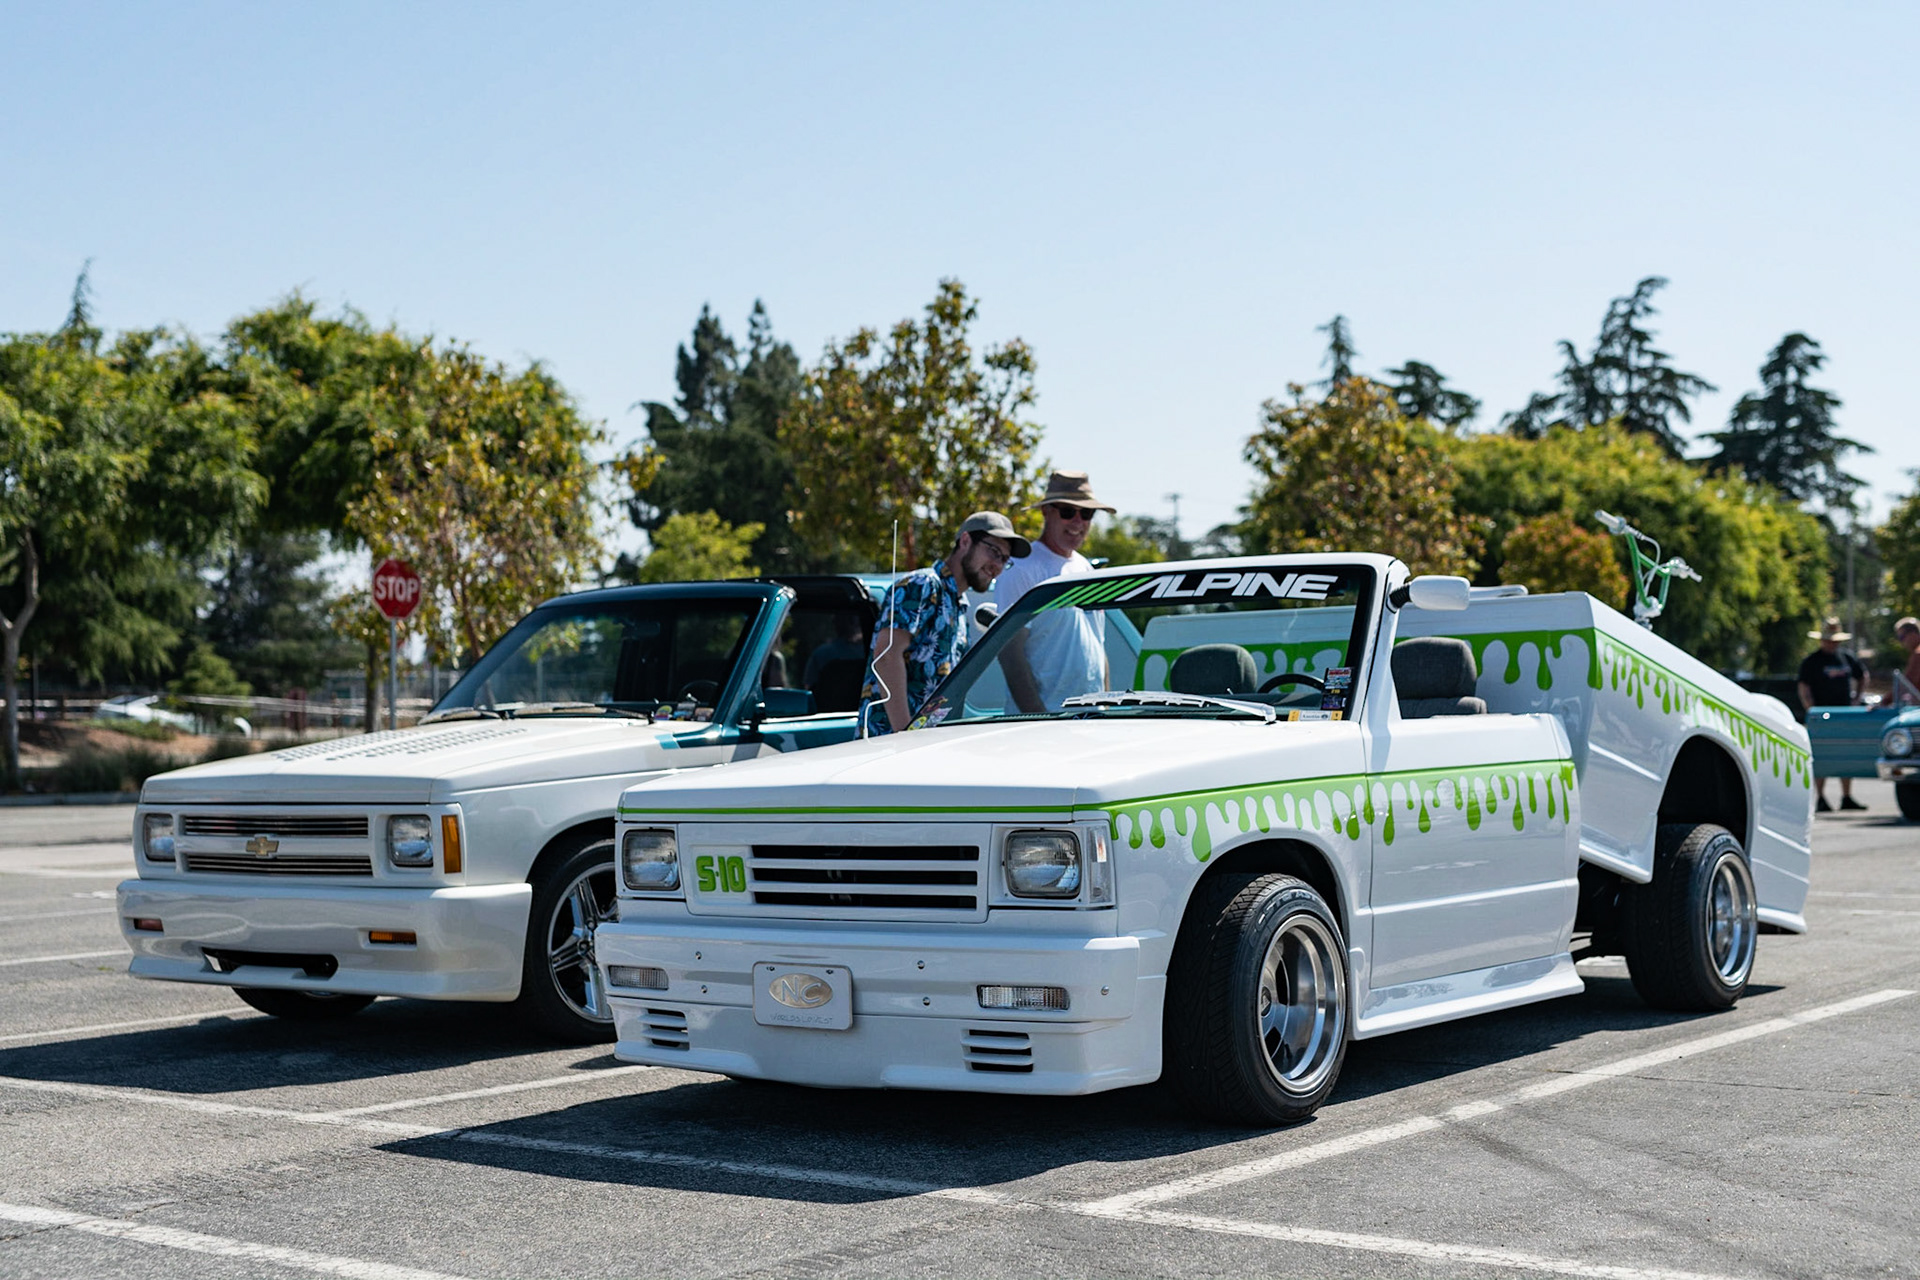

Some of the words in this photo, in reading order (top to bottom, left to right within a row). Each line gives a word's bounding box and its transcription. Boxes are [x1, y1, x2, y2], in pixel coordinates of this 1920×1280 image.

[375, 574, 419, 602] STOP
[1115, 572, 1339, 601] ALPINE
[781, 975, 822, 1004] NC
